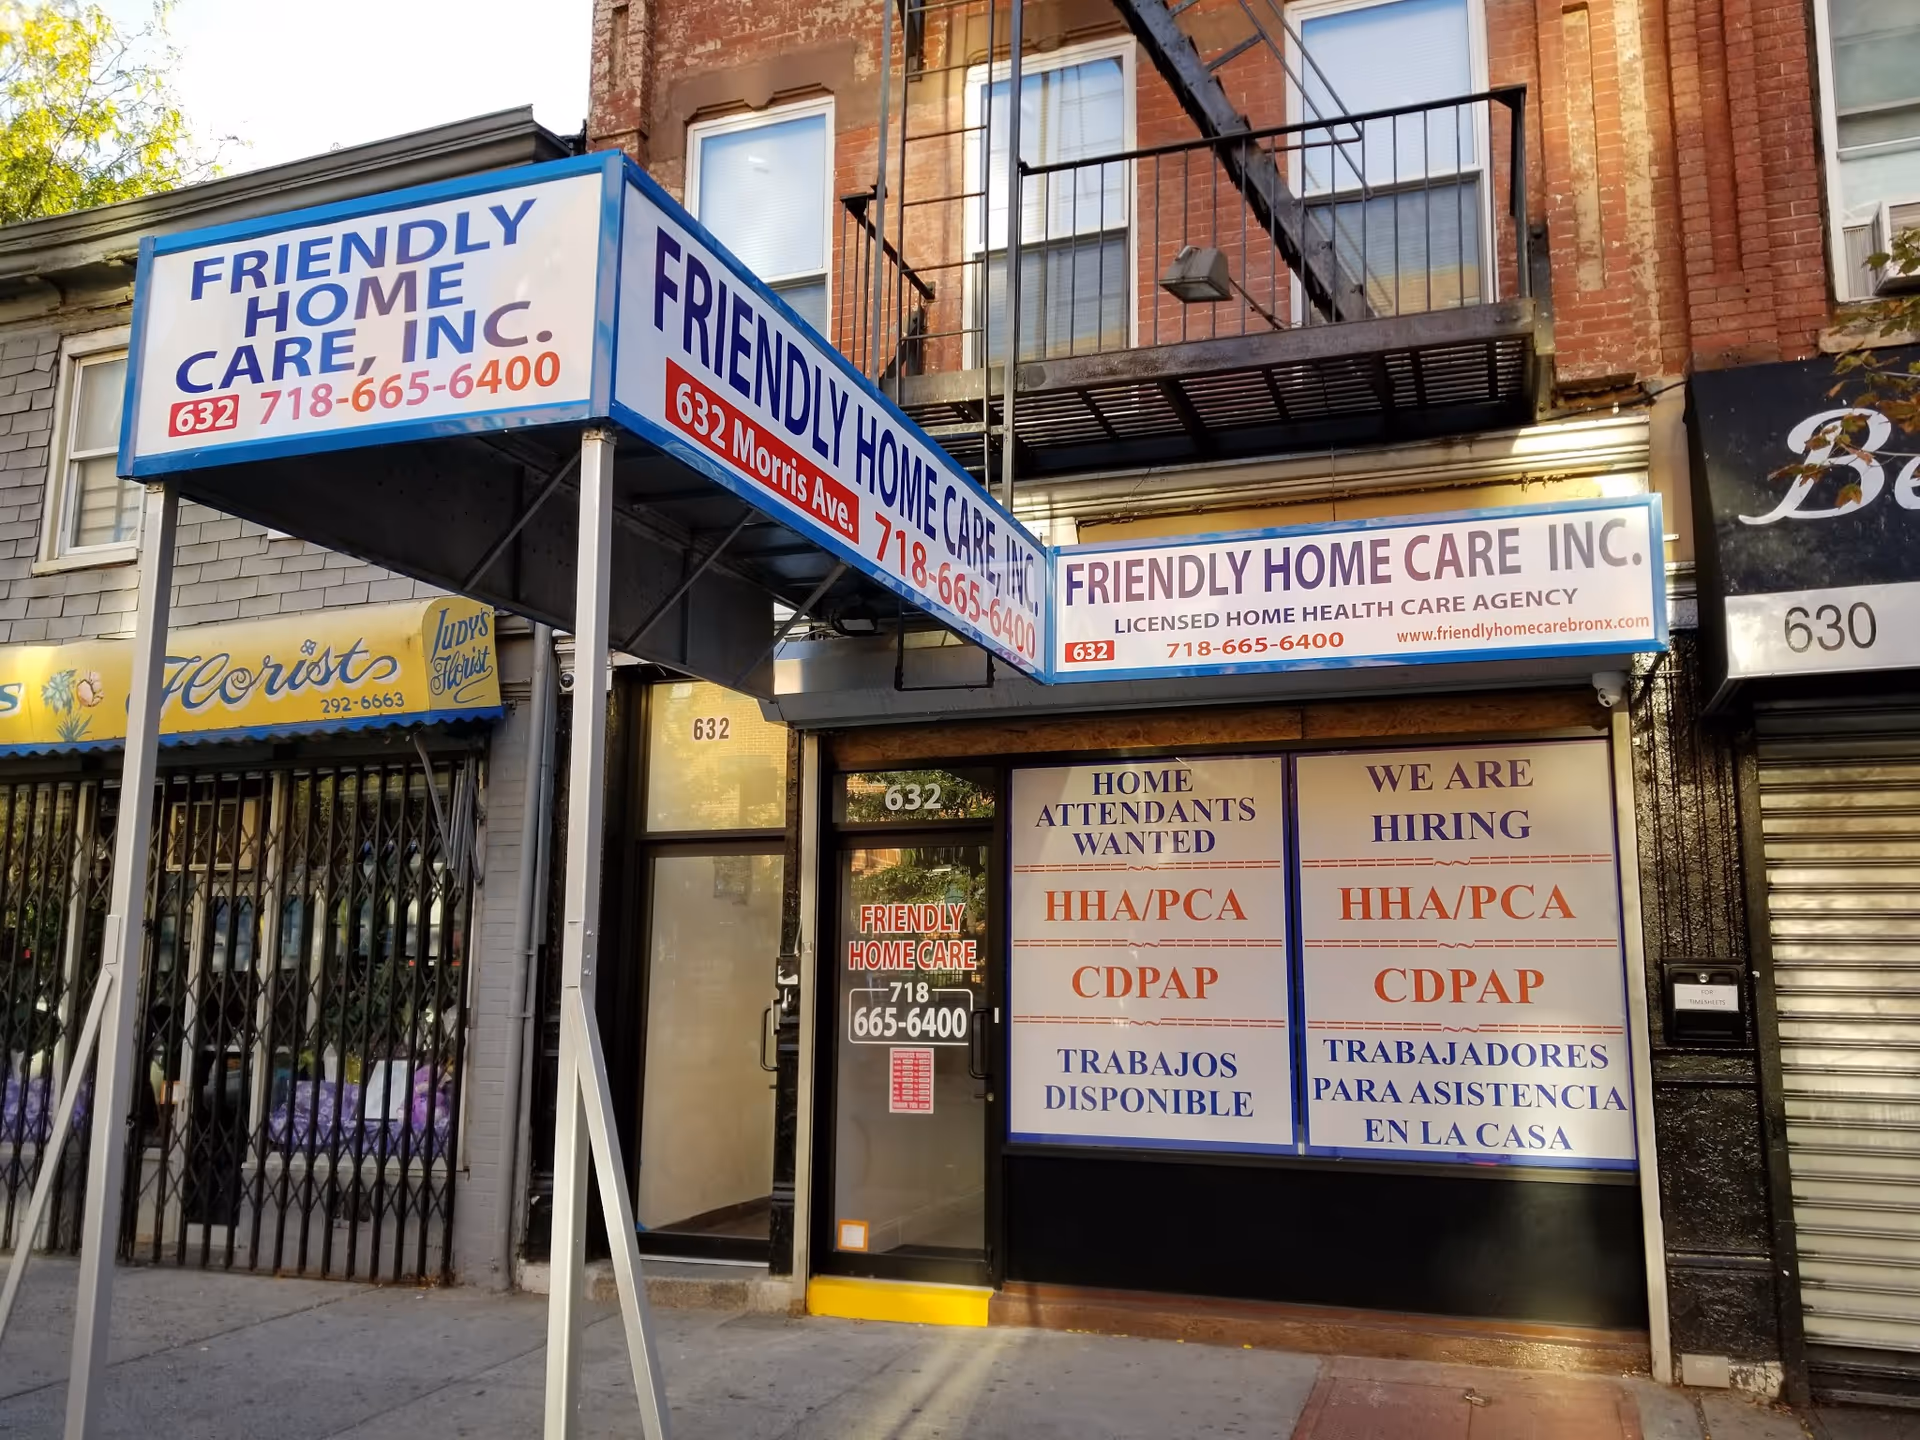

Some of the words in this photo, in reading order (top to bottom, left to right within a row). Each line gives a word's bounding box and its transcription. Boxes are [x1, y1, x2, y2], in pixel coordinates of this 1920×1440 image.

[190, 198, 538, 301] FRIENDLY
[244, 261, 464, 338] HOME
[175, 328, 377, 393] CARE,
[402, 300, 553, 363] INC.
[175, 398, 235, 433] 632
[259, 350, 561, 425] 718-665-6400
[654, 226, 848, 467] FRIENDLY
[856, 405, 938, 542] HOME
[943, 485, 1000, 595] CARE,
[1006, 534, 1039, 618] INC.
[675, 382, 726, 450] 632
[732, 417, 808, 502] Morris
[813, 475, 854, 534] Ave.
[1066, 550, 1252, 606] FRIENDLY
[1264, 538, 1392, 593] HOME
[1404, 527, 1522, 582] CARE
[1549, 518, 1642, 572] INC.
[874, 512, 1036, 660] 718-665-6400
[1115, 612, 1220, 634] LICENSED
[1226, 607, 1295, 627] HOME
[1302, 600, 1393, 622] HEALTH
[1400, 595, 1466, 616] CARE
[1472, 587, 1578, 611] AGENCY
[1784, 601, 1877, 653] 630
[1072, 642, 1108, 660] 632
[1166, 632, 1344, 658] 718-665-6400
[1397, 615, 1650, 643] www.friendlyhomecarebronx.com
[430, 646, 493, 703] Florist
[320, 692, 404, 713] 292-6663
[693, 717, 730, 740] 632
[1092, 768, 1194, 796] HOME
[1365, 764, 1433, 793] WE
[1444, 759, 1534, 791] ARE
[885, 783, 941, 811] 632
[1035, 796, 1257, 827] ATTENDANTS
[1072, 829, 1216, 856] WANTED
[1371, 810, 1532, 842] HIRING
[860, 903, 966, 933] FRIENDLY
[1044, 888, 1249, 922] HHA/PCA
[1338, 884, 1576, 921] HHA/PCA
[849, 940, 915, 970] HOME
[917, 940, 977, 970] CARE
[890, 982, 929, 1002] 718
[1071, 965, 1219, 1000] CDPAP
[1374, 968, 1545, 1004] CDPAP
[854, 1007, 967, 1038] 665-6400
[1057, 1048, 1237, 1079] TRABAJOS
[1323, 1038, 1609, 1069] TRABAJADORES
[1044, 1084, 1255, 1118] DISPONIBLE
[1313, 1077, 1401, 1104] PARA
[1410, 1080, 1628, 1111] ASISTENCIA
[1364, 1118, 1414, 1143] EN
[1420, 1121, 1469, 1147] LA
[1475, 1123, 1574, 1151] CASA
